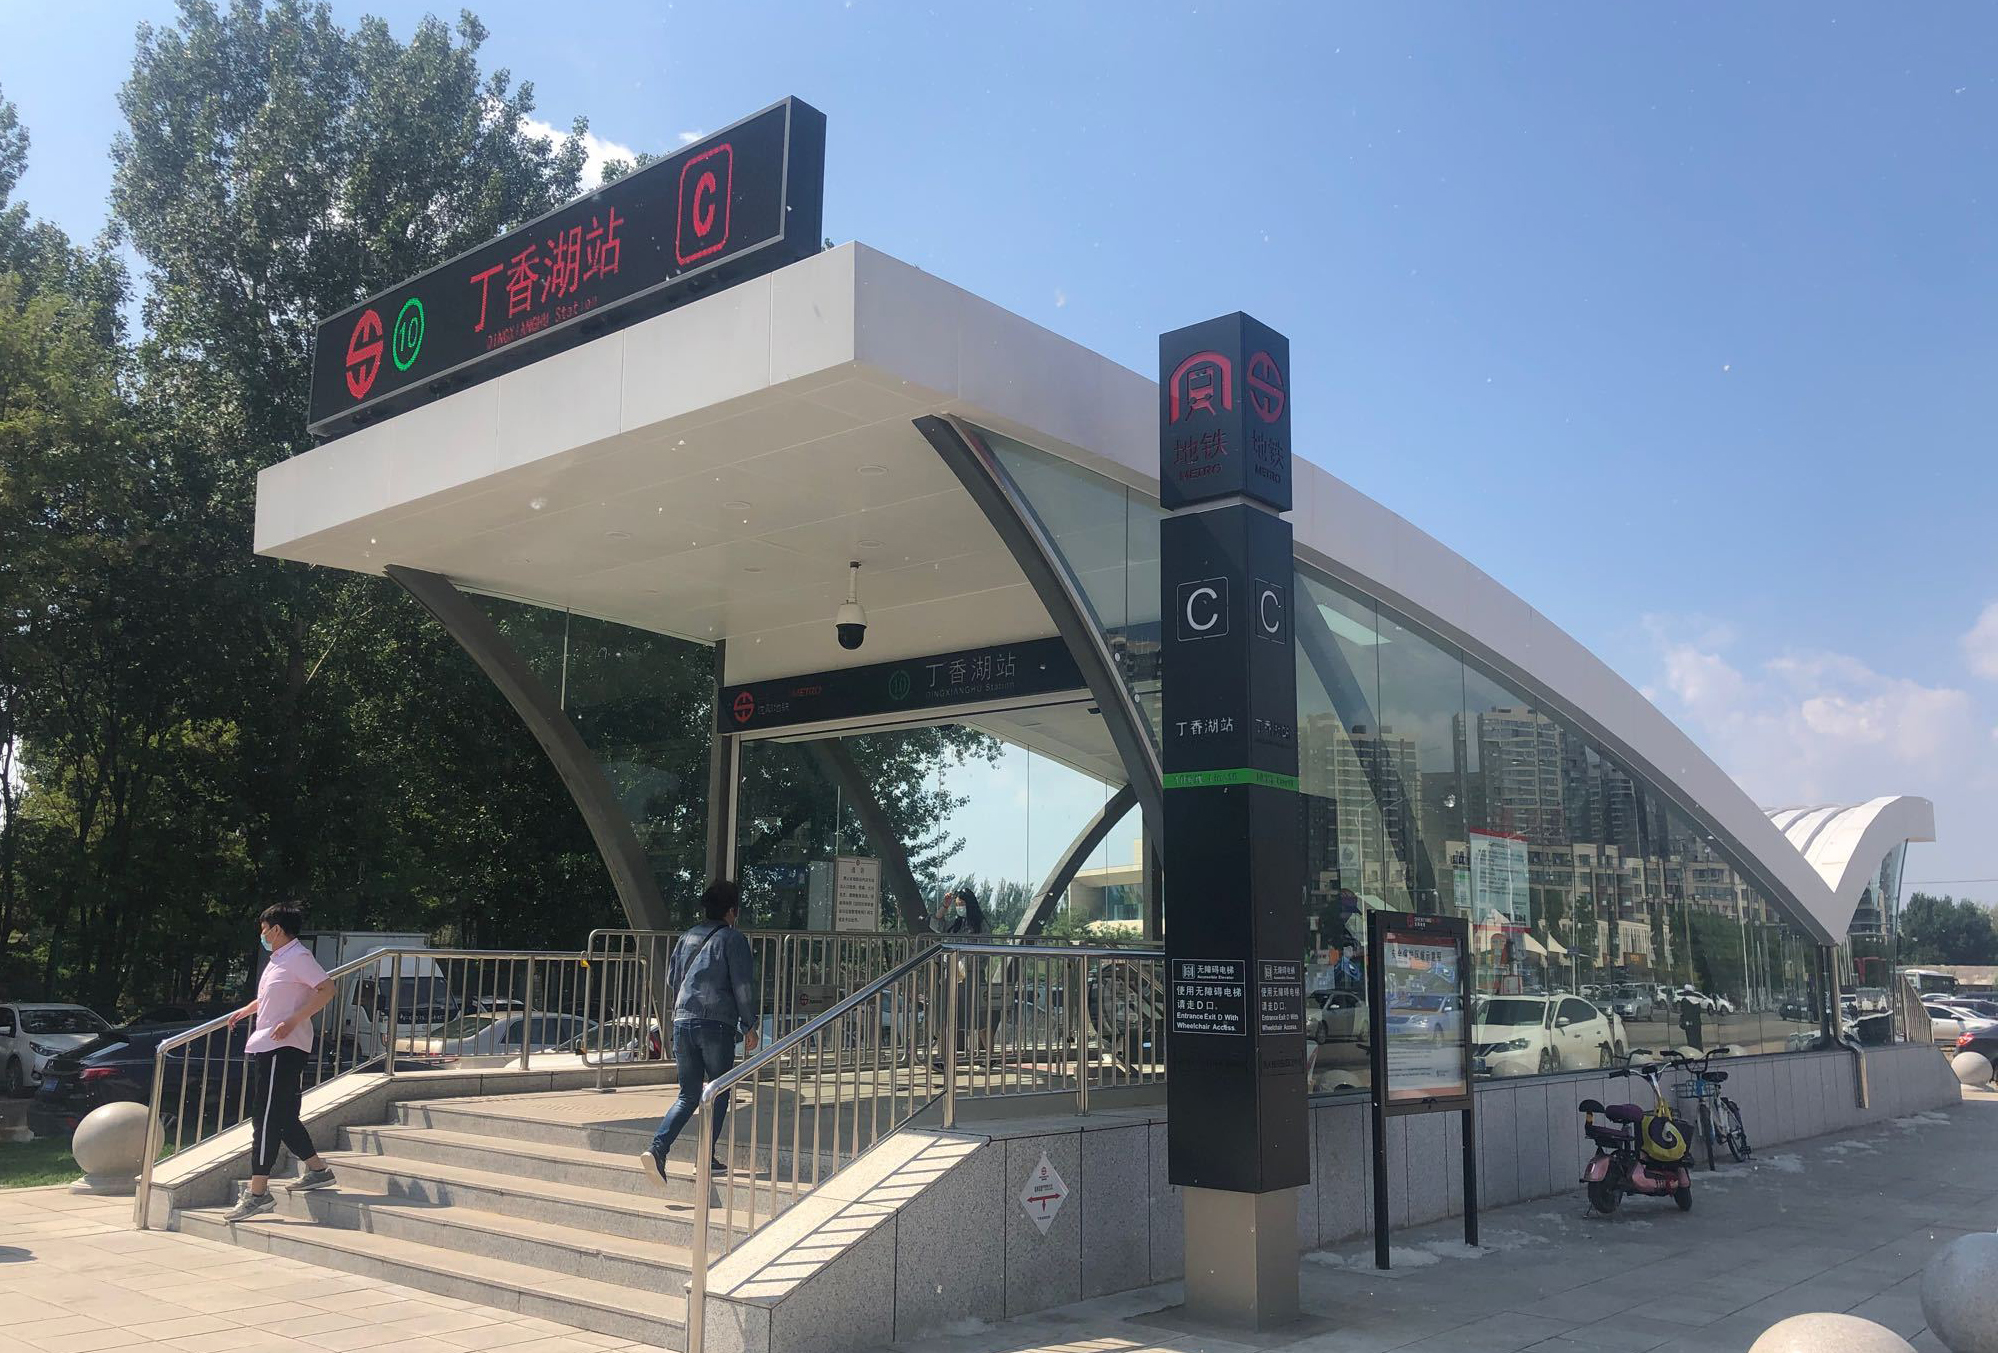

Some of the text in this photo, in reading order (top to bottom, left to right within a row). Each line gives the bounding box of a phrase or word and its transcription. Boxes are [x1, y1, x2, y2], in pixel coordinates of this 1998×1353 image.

[692, 171, 717, 237] C
[470, 207, 625, 333] 丁香湖站
[398, 319, 419, 354] 10
[1174, 429, 1229, 465] 地铁
[1252, 429, 1285, 470] 地铁
[1179, 463, 1223, 482] METRO
[1254, 463, 1282, 484] METRO
[1186, 587, 1218, 632] C
[1260, 590, 1280, 633] C
[926, 651, 1017, 688] 丁香湖站
[926, 685, 982, 699] DINGXIANGHU
[1175, 717, 1234, 737] 丁香湖站
[1197, 965, 1235, 975] 无障碍电梯
[1176, 985, 1242, 998] 使用无障碍电梯
[1261, 986, 1301, 998] 使用无障碍电梯
[1176, 1011, 1204, 1020] Entrance
[1224, 1014, 1239, 1022] With
[1176, 1021, 1211, 1030] Wheelchair
